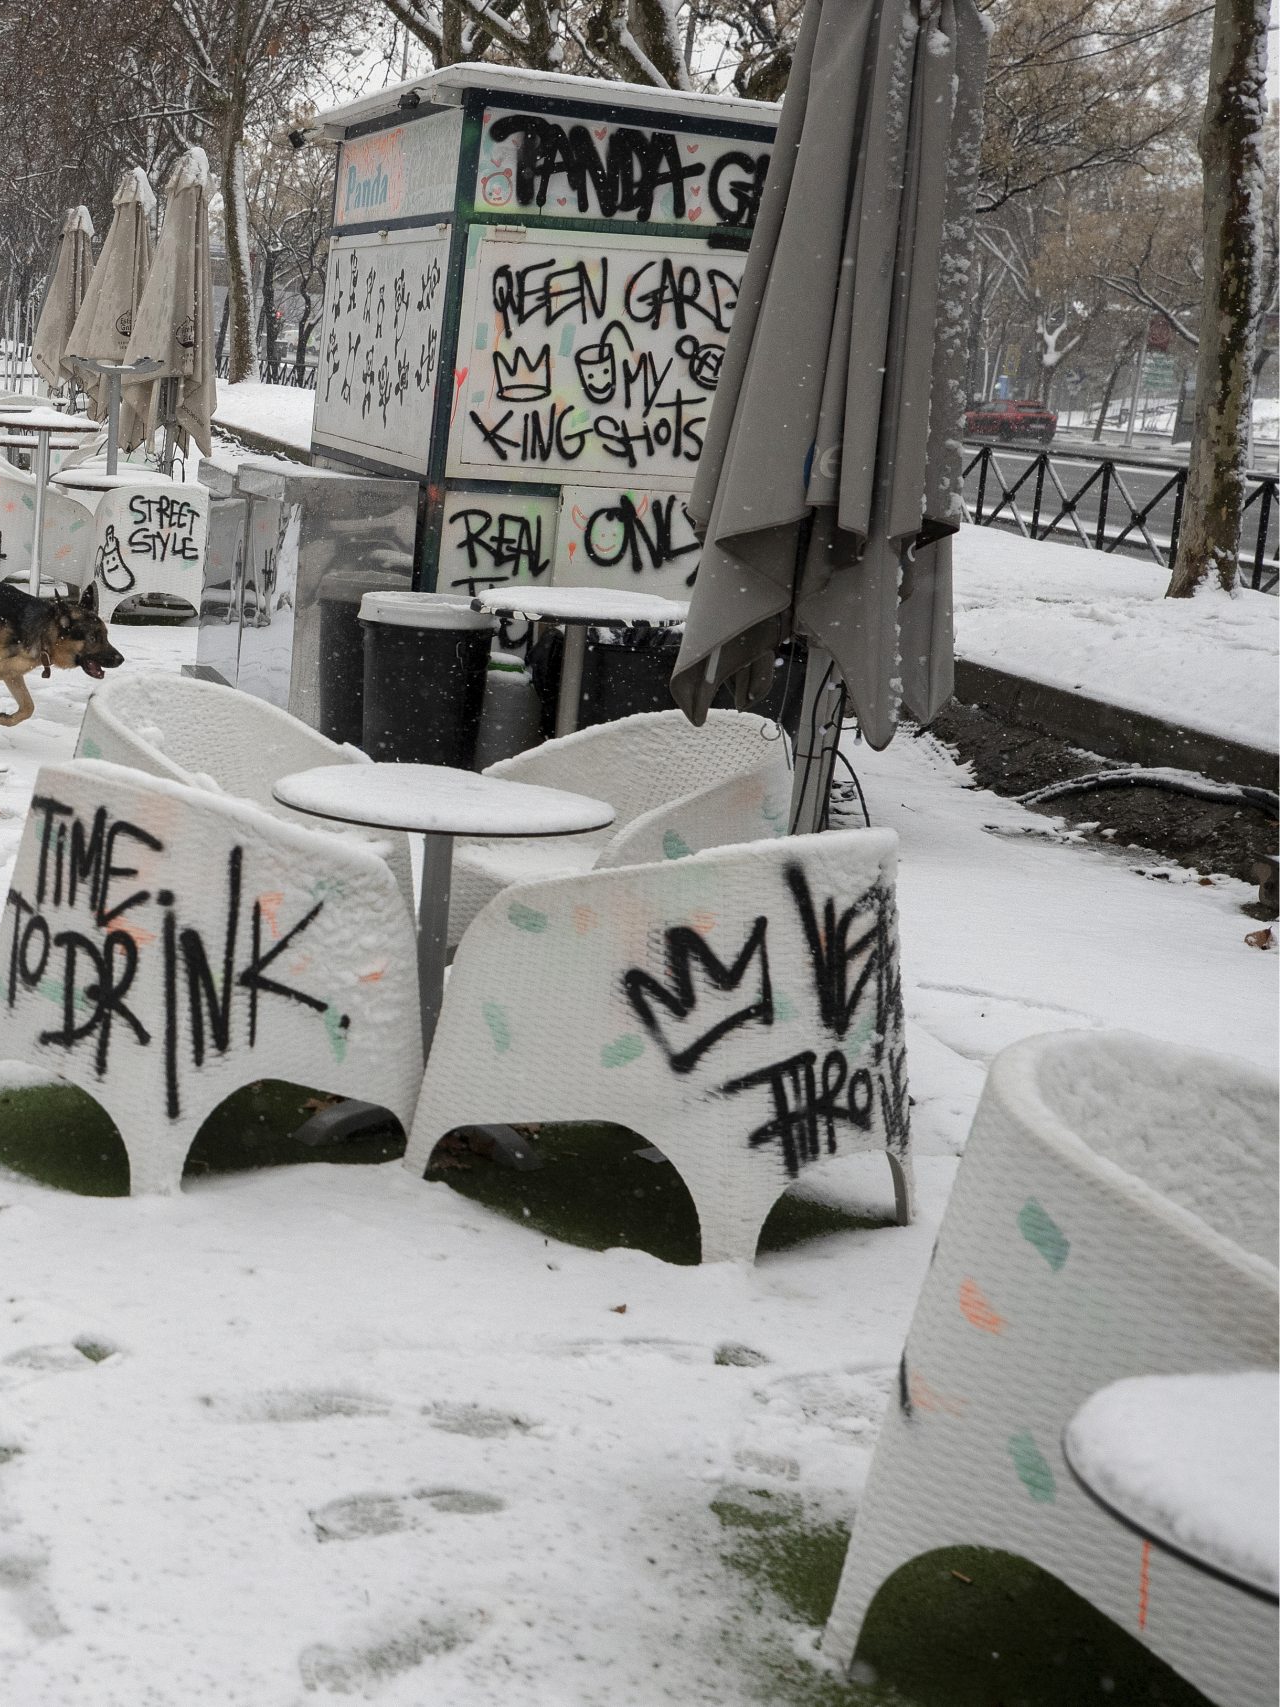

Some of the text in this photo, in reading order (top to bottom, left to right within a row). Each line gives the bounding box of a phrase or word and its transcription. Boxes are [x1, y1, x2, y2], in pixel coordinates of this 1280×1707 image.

[490, 114, 706, 222] PANDA
[624, 257, 743, 333] GARD
[622, 351, 673, 417] MY
[128, 527, 199, 563] STYLE
[129, 494, 200, 535] STREET
[449, 508, 551, 577] REAL
[31, 795, 165, 927] TIME
[7, 888, 51, 1009] TO
